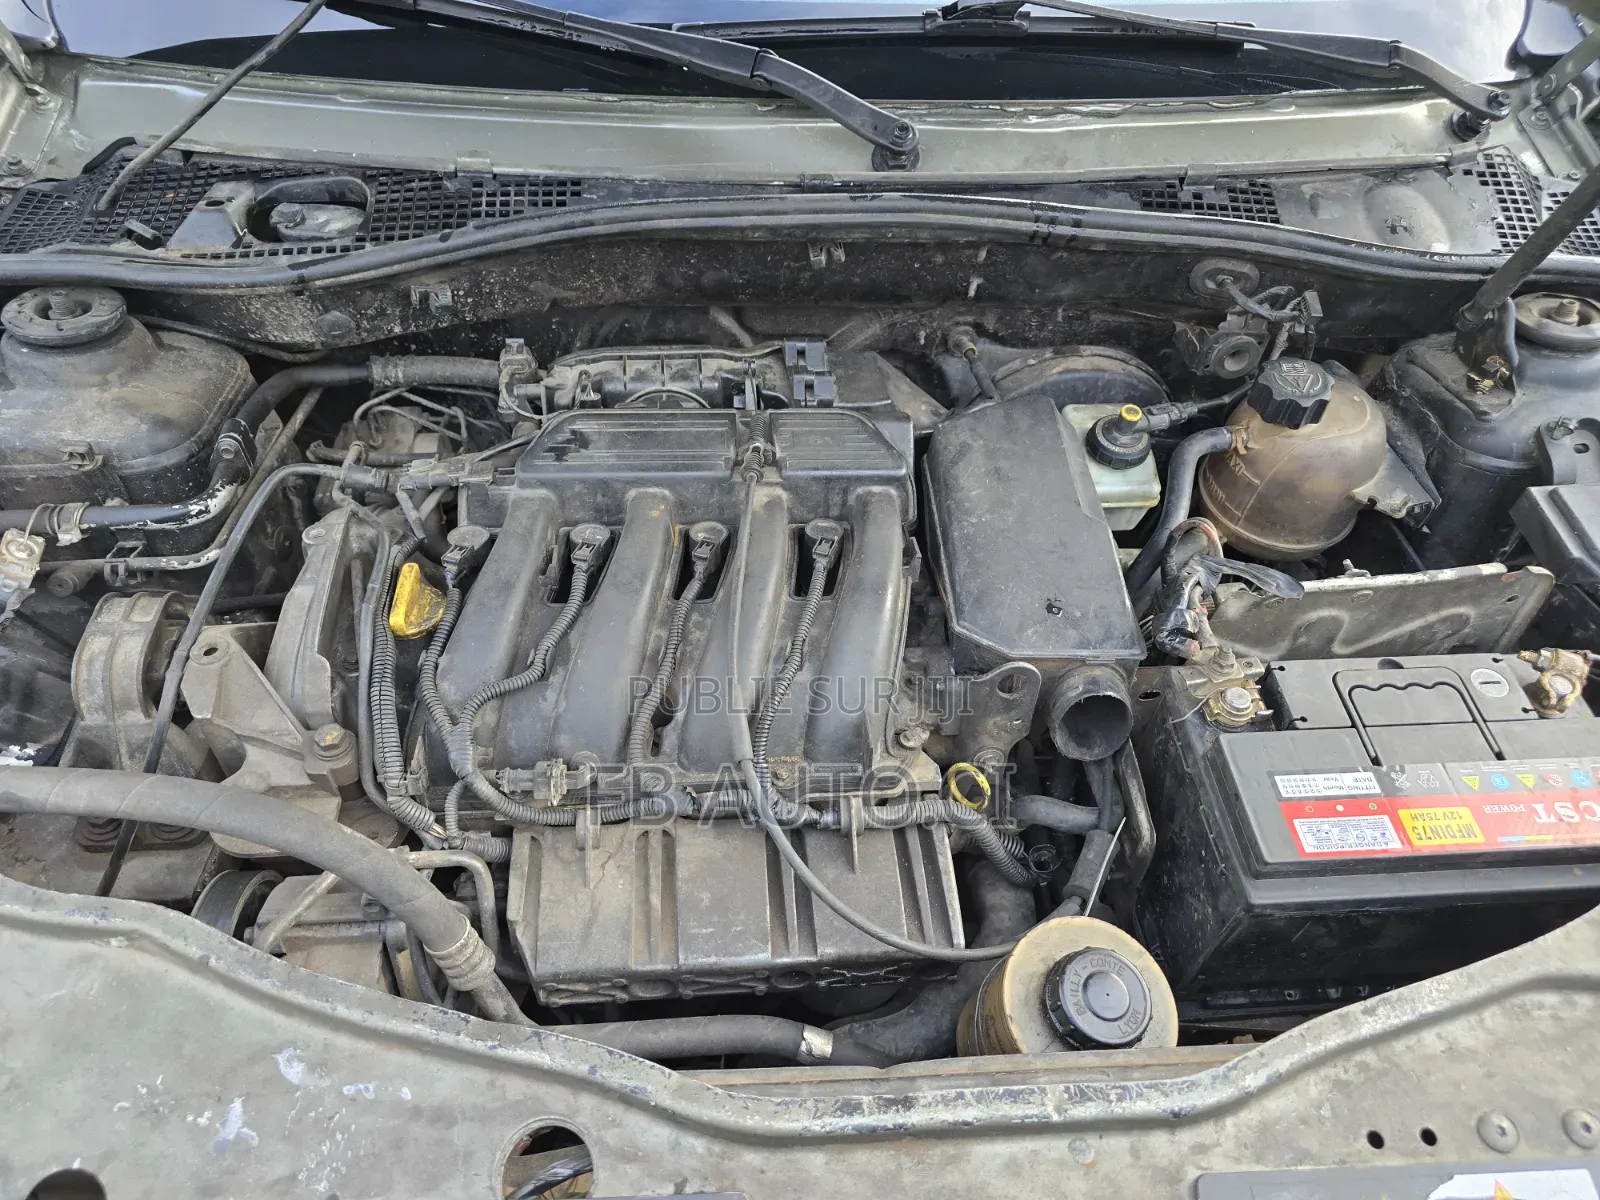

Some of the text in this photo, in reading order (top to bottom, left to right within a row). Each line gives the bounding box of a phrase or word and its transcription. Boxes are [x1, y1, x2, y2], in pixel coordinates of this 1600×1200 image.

[1409, 810, 1464, 822] 12V 75AH
[1482, 803, 1527, 814] POWER
[1411, 823, 1479, 841] MFDIN75
[1070, 968, 1087, 1016] BAILLY
[1089, 957, 1126, 976] COMTE
[1117, 1007, 1142, 1035] LYON
